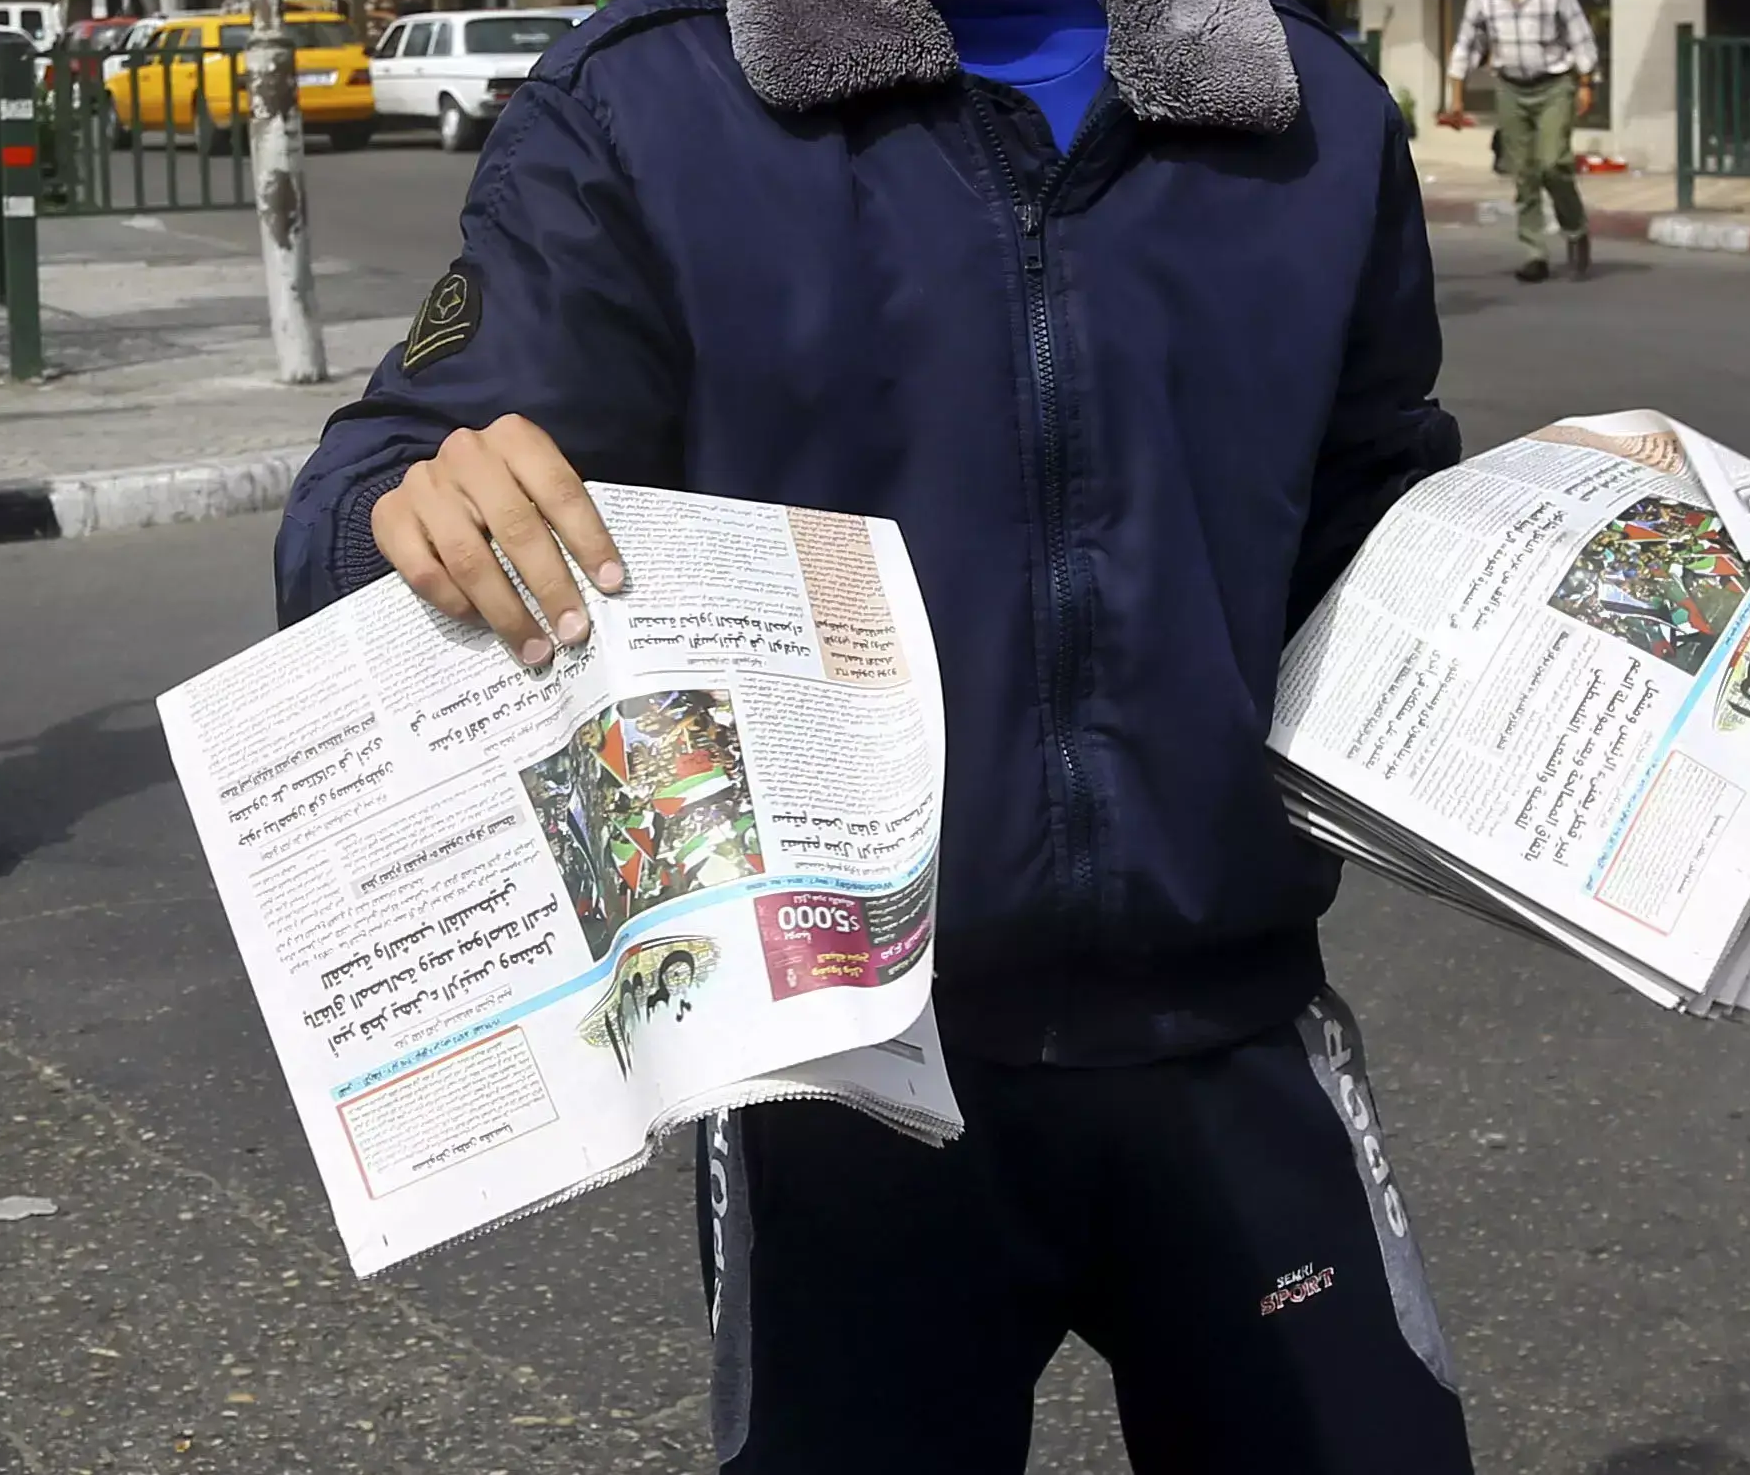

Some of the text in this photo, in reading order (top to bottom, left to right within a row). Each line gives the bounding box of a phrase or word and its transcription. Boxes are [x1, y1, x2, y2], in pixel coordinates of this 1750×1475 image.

[1500, 570, 1509, 584] من
[628, 611, 802, 636] المتحدة تجاوز الخطوط الحمراء
[628, 631, 810, 656] التجسس الإسرائيلي في الولايات
[409, 709, 426, 736] في
[428, 727, 464, 751] عشرة
[464, 716, 490, 741] آلاف
[491, 702, 510, 720] من
[513, 690, 539, 711] عرب
[1514, 668, 1605, 829] للقضية والشعب الفلسطيني
[228, 736, 382, 822] يعتدون على ممتلكات في أخرى
[1520, 656, 1641, 861] باتفاق المصالحة ويعد بمواصلة الدعم
[1552, 836, 1569, 867] أمير
[1566, 808, 1586, 839] قطر
[1603, 724, 1627, 771] الرئيس
[1624, 678, 1659, 723] ومشعل
[238, 760, 393, 846] جنود يداهمون قرى ومستوطنون
[771, 810, 807, 827] سيتم
[811, 817, 842, 830] ضمن
[846, 819, 879, 836] اتفاق
[360, 874, 377, 894] قطر
[403, 850, 427, 873] تقديم
[437, 835, 463, 854] مليون
[780, 835, 820, 852] تسليم
[823, 840, 853, 857] منزل
[856, 836, 905, 859] الرئيس
[834, 877, 893, 896] Wednesday
[320, 877, 516, 989] للقضية والشعب الفلسطيني
[778, 905, 859, 932] $5,000
[302, 892, 558, 1028] باتفاق المصالحة ويعد بمواصلة الدعم
[327, 1022, 355, 1057] أمير
[359, 1006, 388, 1040] قطر
[441, 959, 495, 1000] الرئيس
[499, 931, 554, 969] ومشعل
[1260, 1266, 1334, 1316] SPORT
